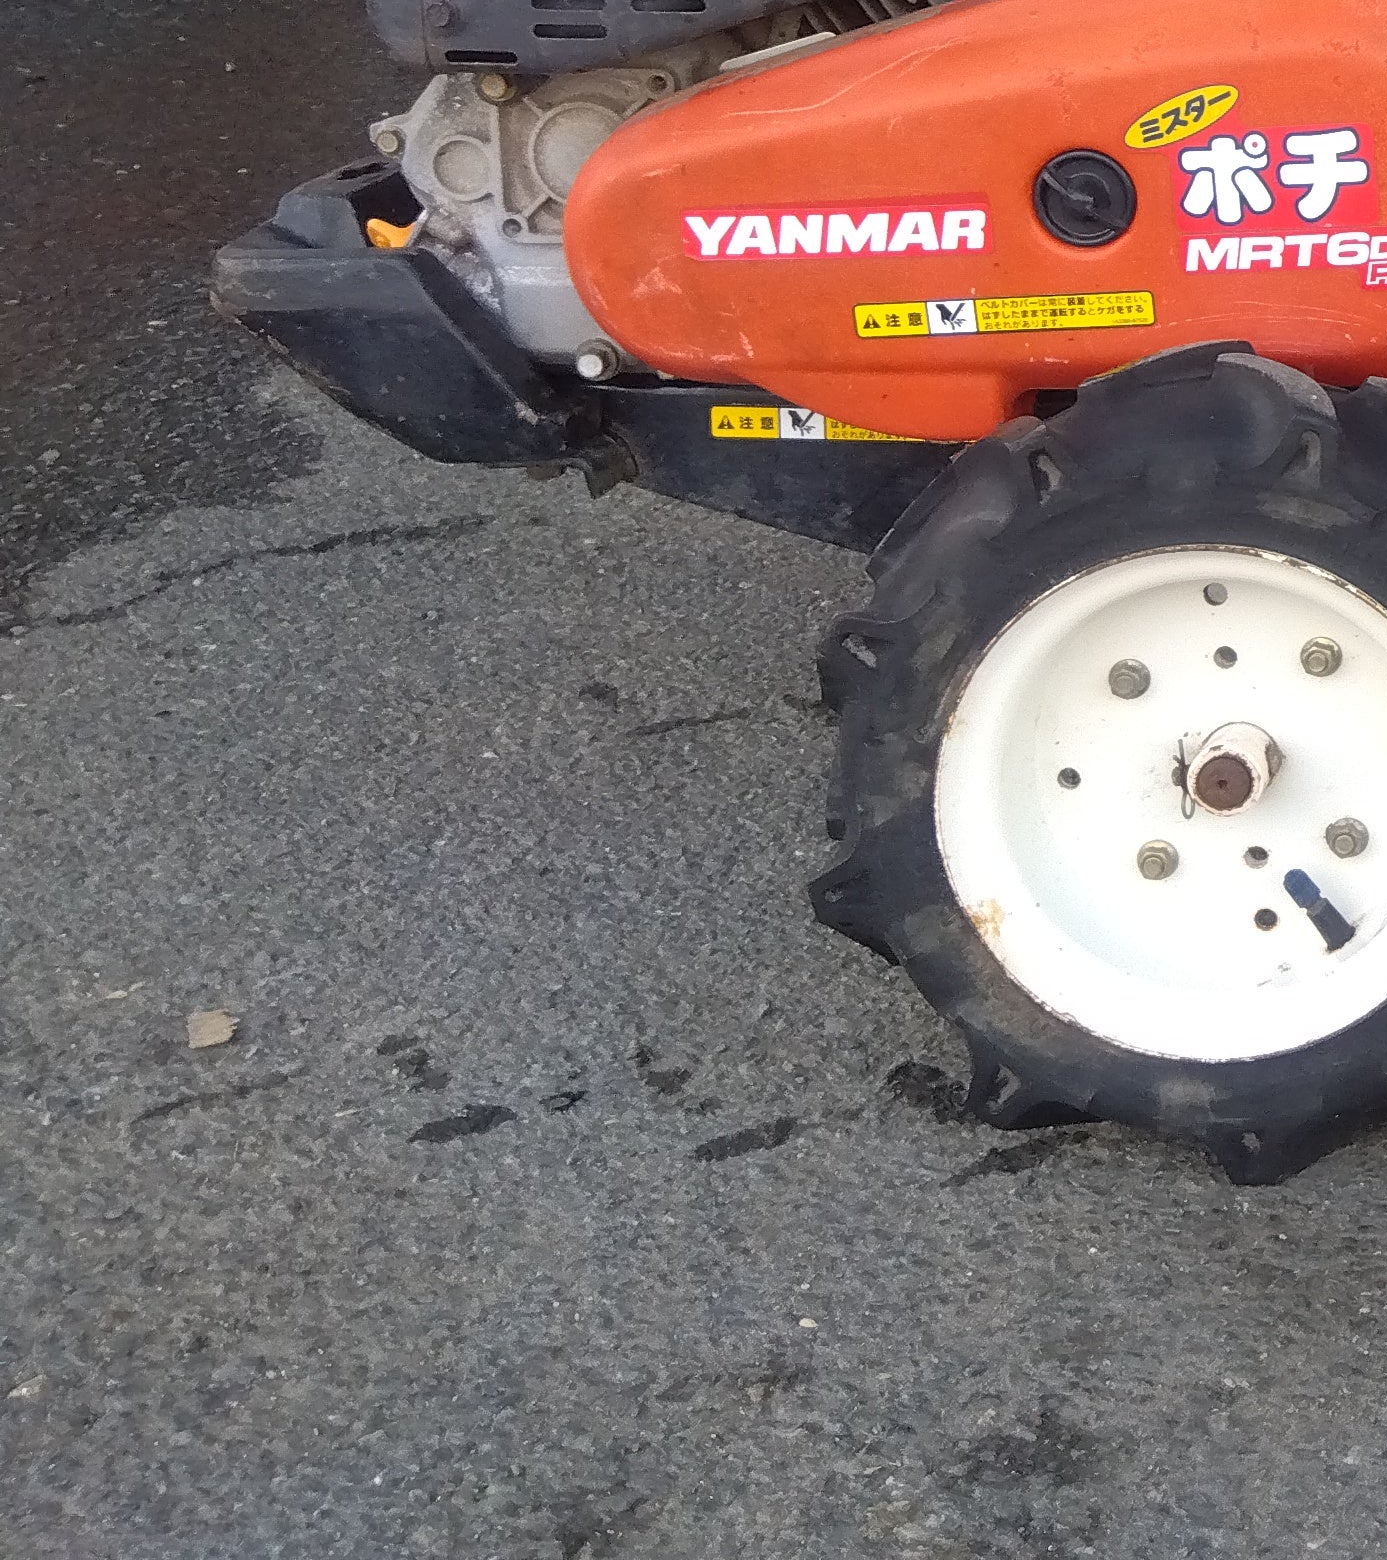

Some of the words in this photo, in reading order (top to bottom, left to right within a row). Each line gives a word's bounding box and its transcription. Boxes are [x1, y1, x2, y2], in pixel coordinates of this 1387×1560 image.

[1140, 90, 1232, 143] ミスター
[1178, 127, 1370, 226] ポチ
[685, 209, 987, 256] YANMAR
[886, 313, 923, 328] 注意
[739, 416, 774, 430] 注意
